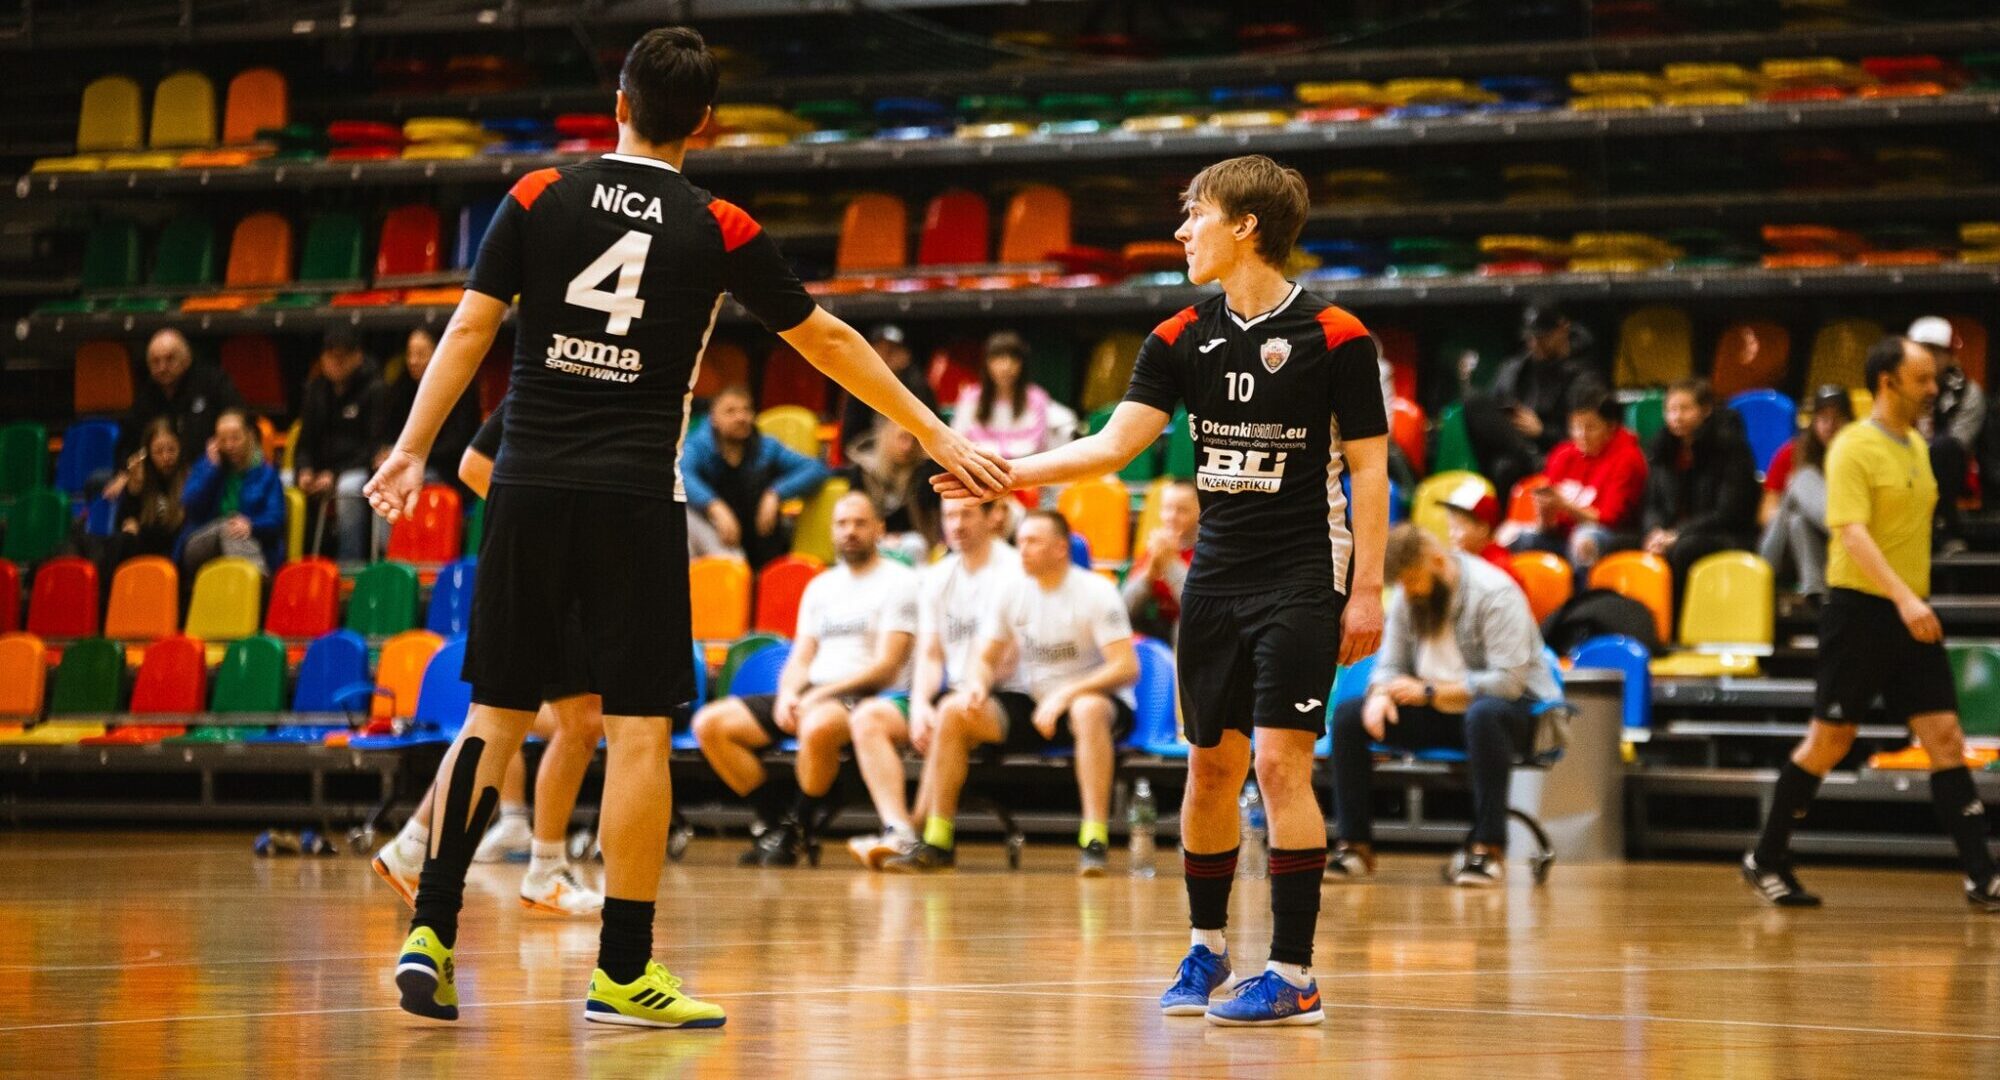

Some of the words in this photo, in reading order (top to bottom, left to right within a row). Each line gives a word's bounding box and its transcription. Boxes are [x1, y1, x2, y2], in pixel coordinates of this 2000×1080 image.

[591, 183, 663, 224] NĪCA
[565, 229, 653, 336] 4
[545, 358, 641, 383] SPORTWIN.LV
[1224, 371, 1255, 403] 10
[1201, 419, 1307, 440] OtankiMill.eu
[1202, 436, 1228, 446] Logistics
[1228, 438, 1252, 448] Services
[1271, 441, 1307, 450] Processing
